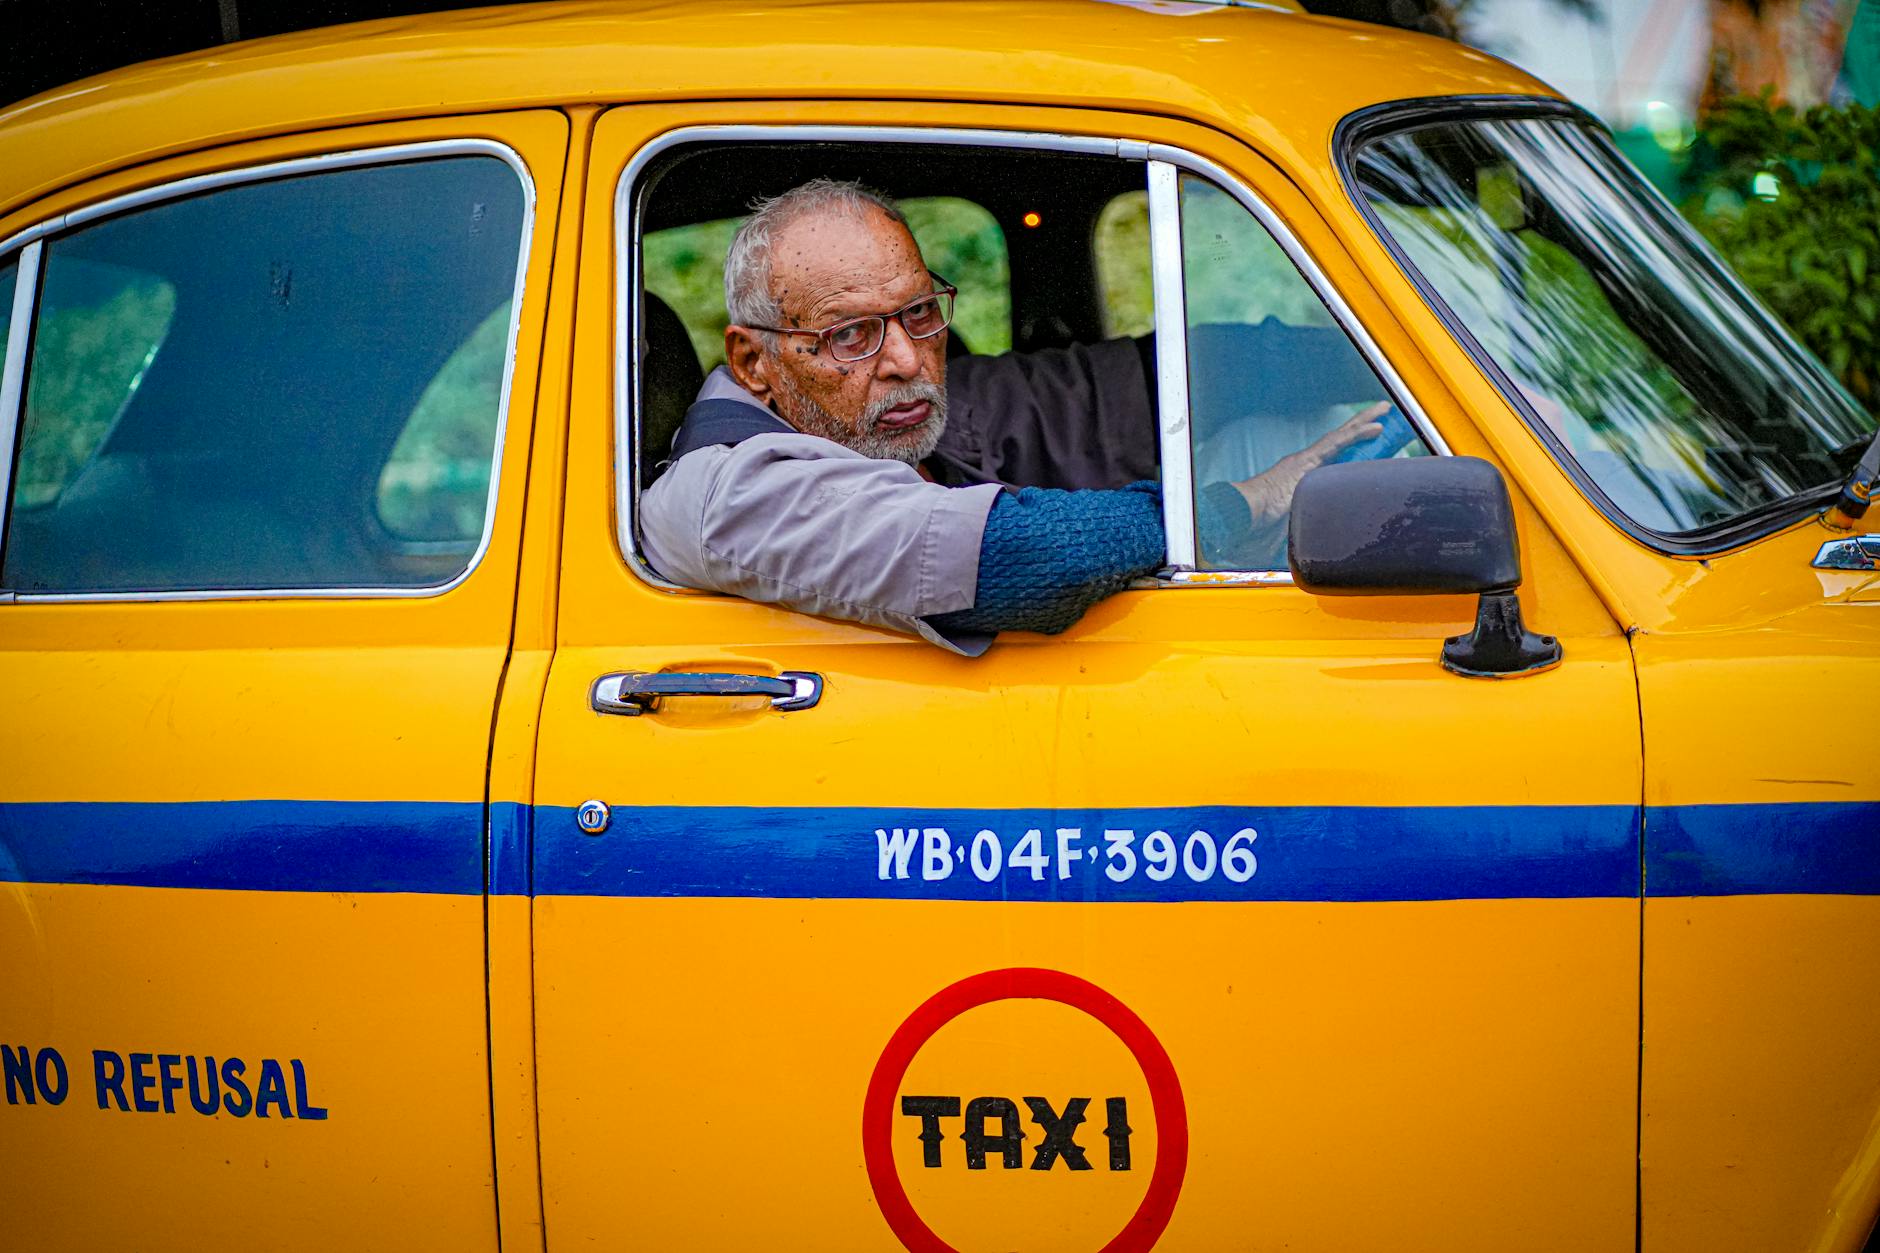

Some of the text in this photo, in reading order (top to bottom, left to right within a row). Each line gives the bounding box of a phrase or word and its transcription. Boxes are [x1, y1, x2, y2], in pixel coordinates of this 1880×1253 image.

[0, 1044, 328, 1120] NO REFUSAL
[901, 1095, 1133, 1171] TAXI
